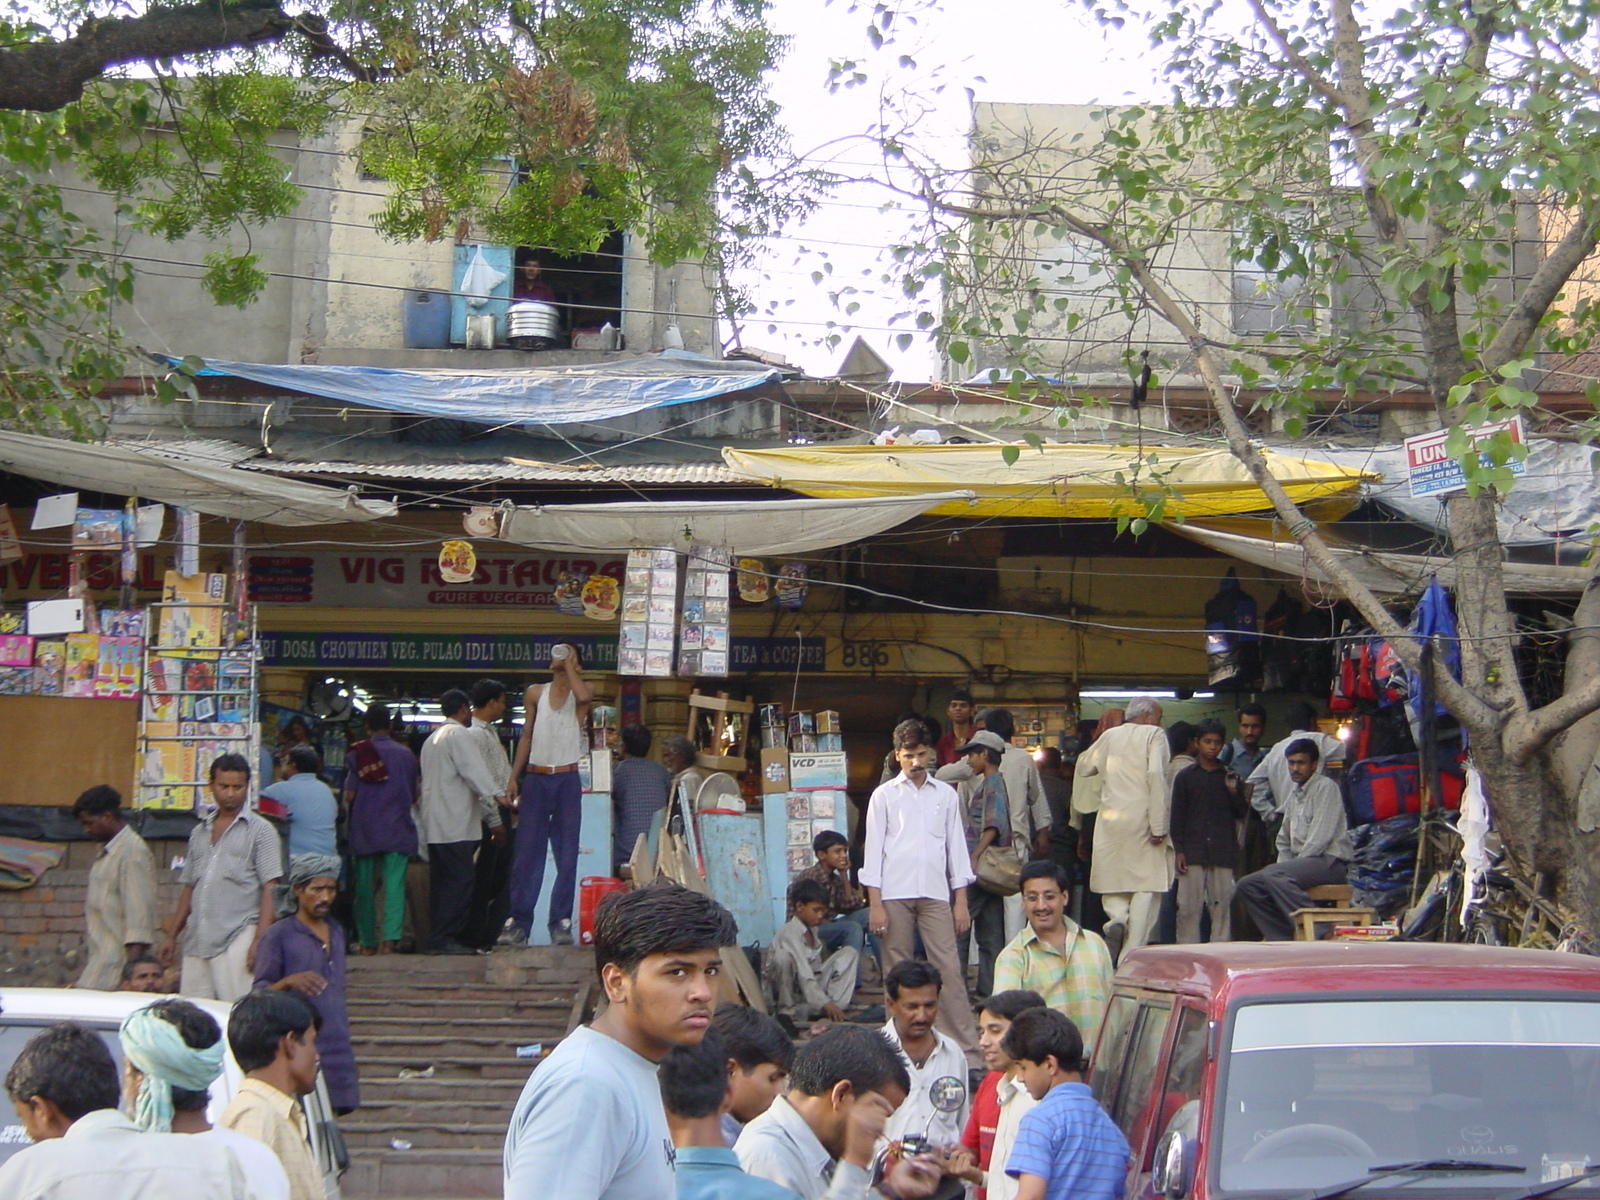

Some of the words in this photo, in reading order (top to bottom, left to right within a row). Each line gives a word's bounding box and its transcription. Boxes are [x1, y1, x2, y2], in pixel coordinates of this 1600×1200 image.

[0, 552, 165, 590] VESL
[340, 557, 405, 584] VIG
[420, 557, 626, 588] RSTAURA
[435, 591, 477, 603] PURE
[484, 592, 557, 605] VEGETAR
[282, 640, 317, 658] DOSA
[321, 641, 388, 659] CHOWMIEN
[391, 641, 420, 660] VEG.
[423, 642, 462, 660] PULAO
[466, 642, 495, 661] IDLI
[499, 643, 531, 661] VADA
[534, 643, 593, 662] BHRA
[733, 645, 757, 664] TEA
[773, 646, 823, 664] COFFEE
[842, 643, 889, 667] 886
[791, 758, 816, 768] VCD
[1447, 1144, 1518, 1156] QUALIS
